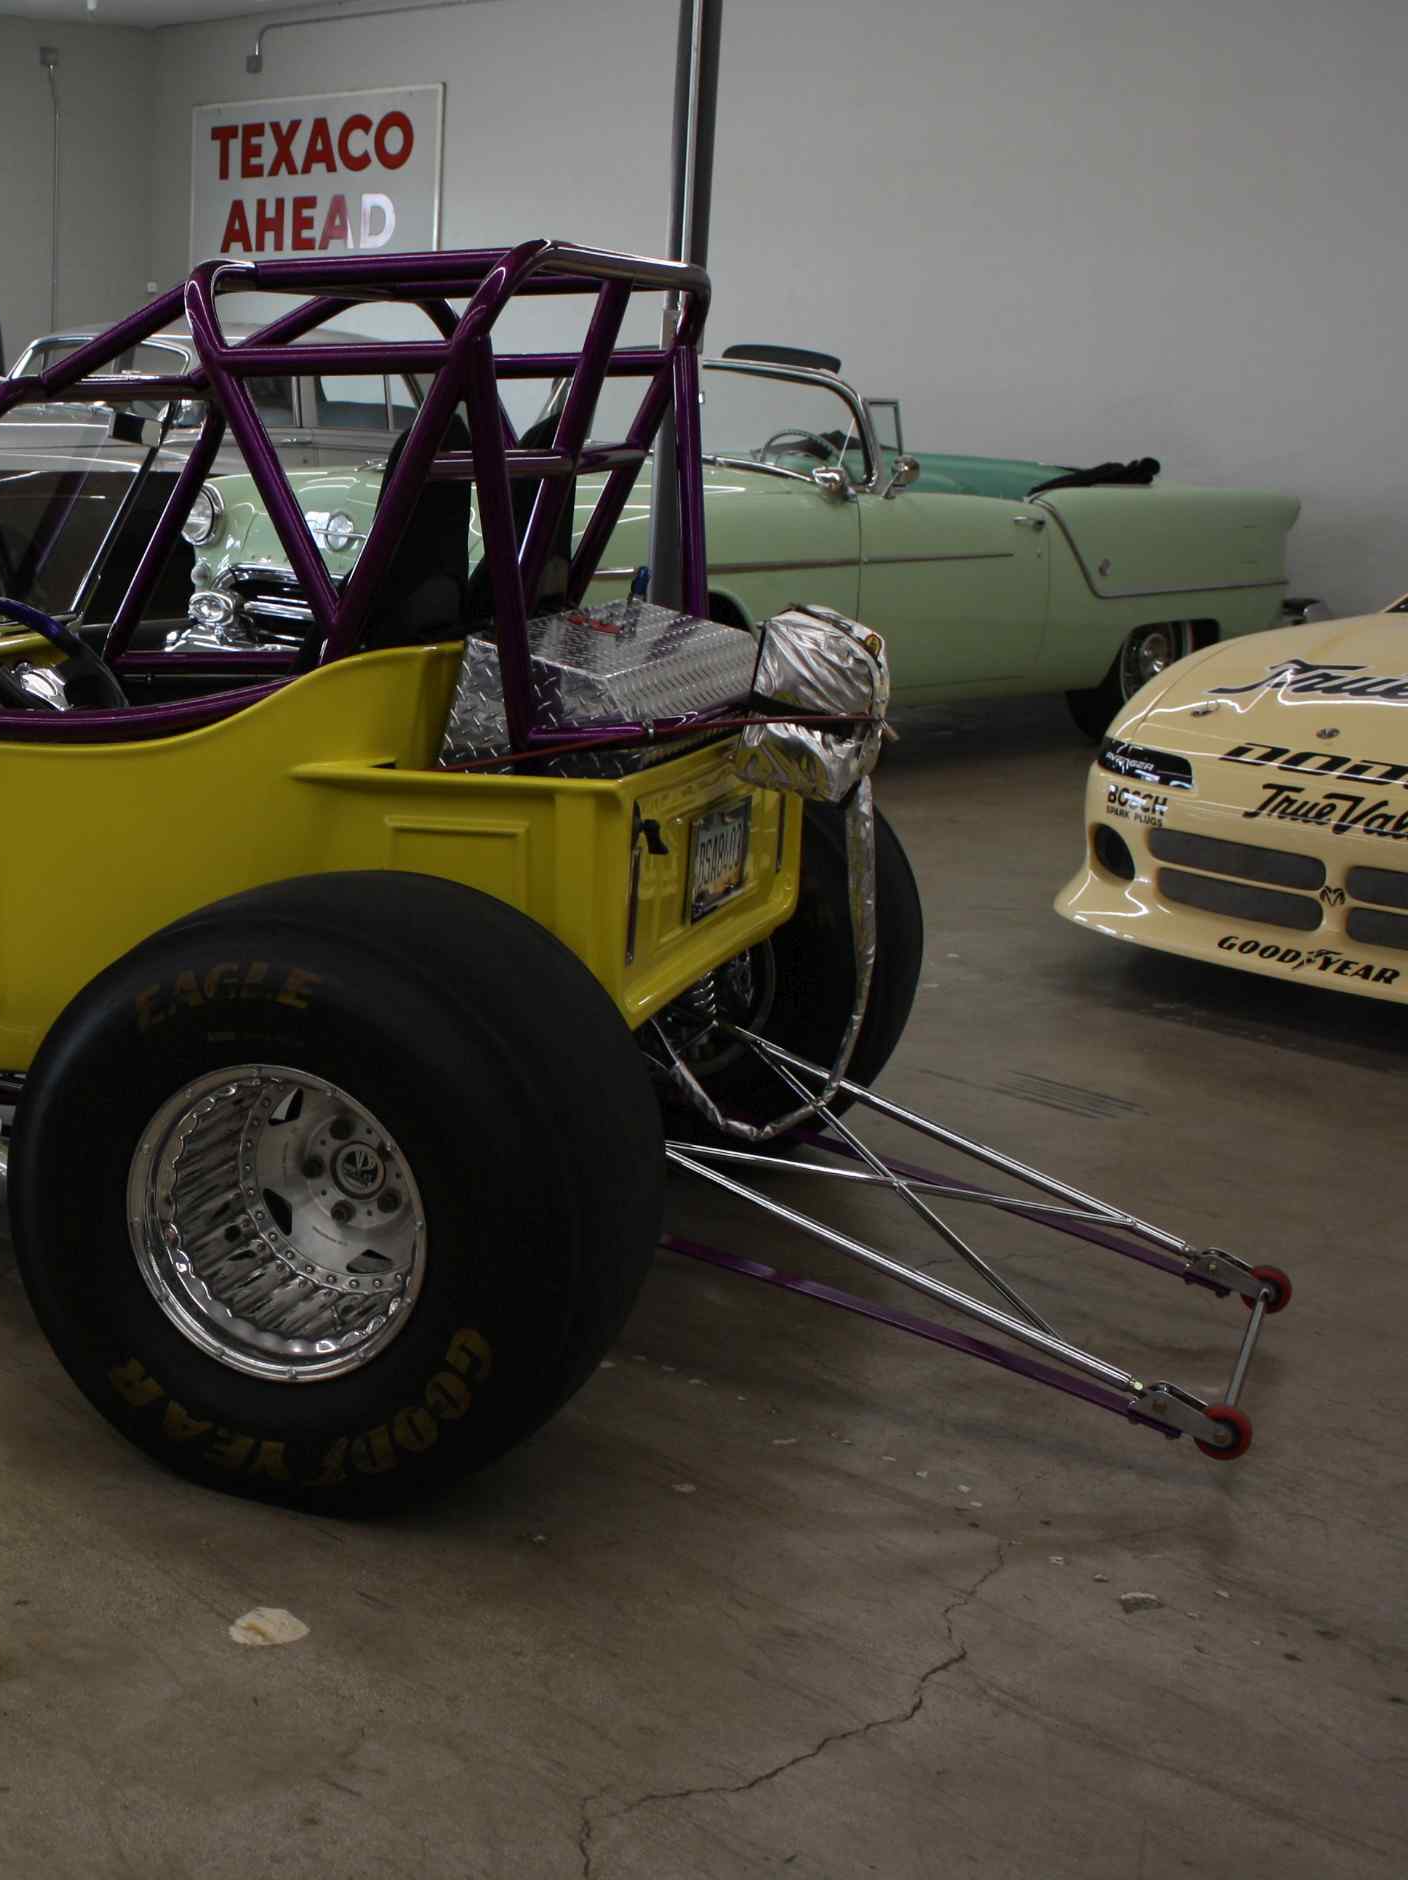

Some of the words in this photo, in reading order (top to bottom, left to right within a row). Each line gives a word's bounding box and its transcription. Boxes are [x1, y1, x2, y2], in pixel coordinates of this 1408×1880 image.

[211, 110, 414, 181] TEXACO
[220, 192, 396, 253] AHEAD
[1218, 742, 1408, 789] DOD
[1106, 804, 1129, 817] SPARK
[1135, 814, 1163, 827] PLUGS
[1108, 784, 1168, 816] BOSCH
[1242, 783, 1337, 825] True
[135, 959, 322, 1031] EAGLE
